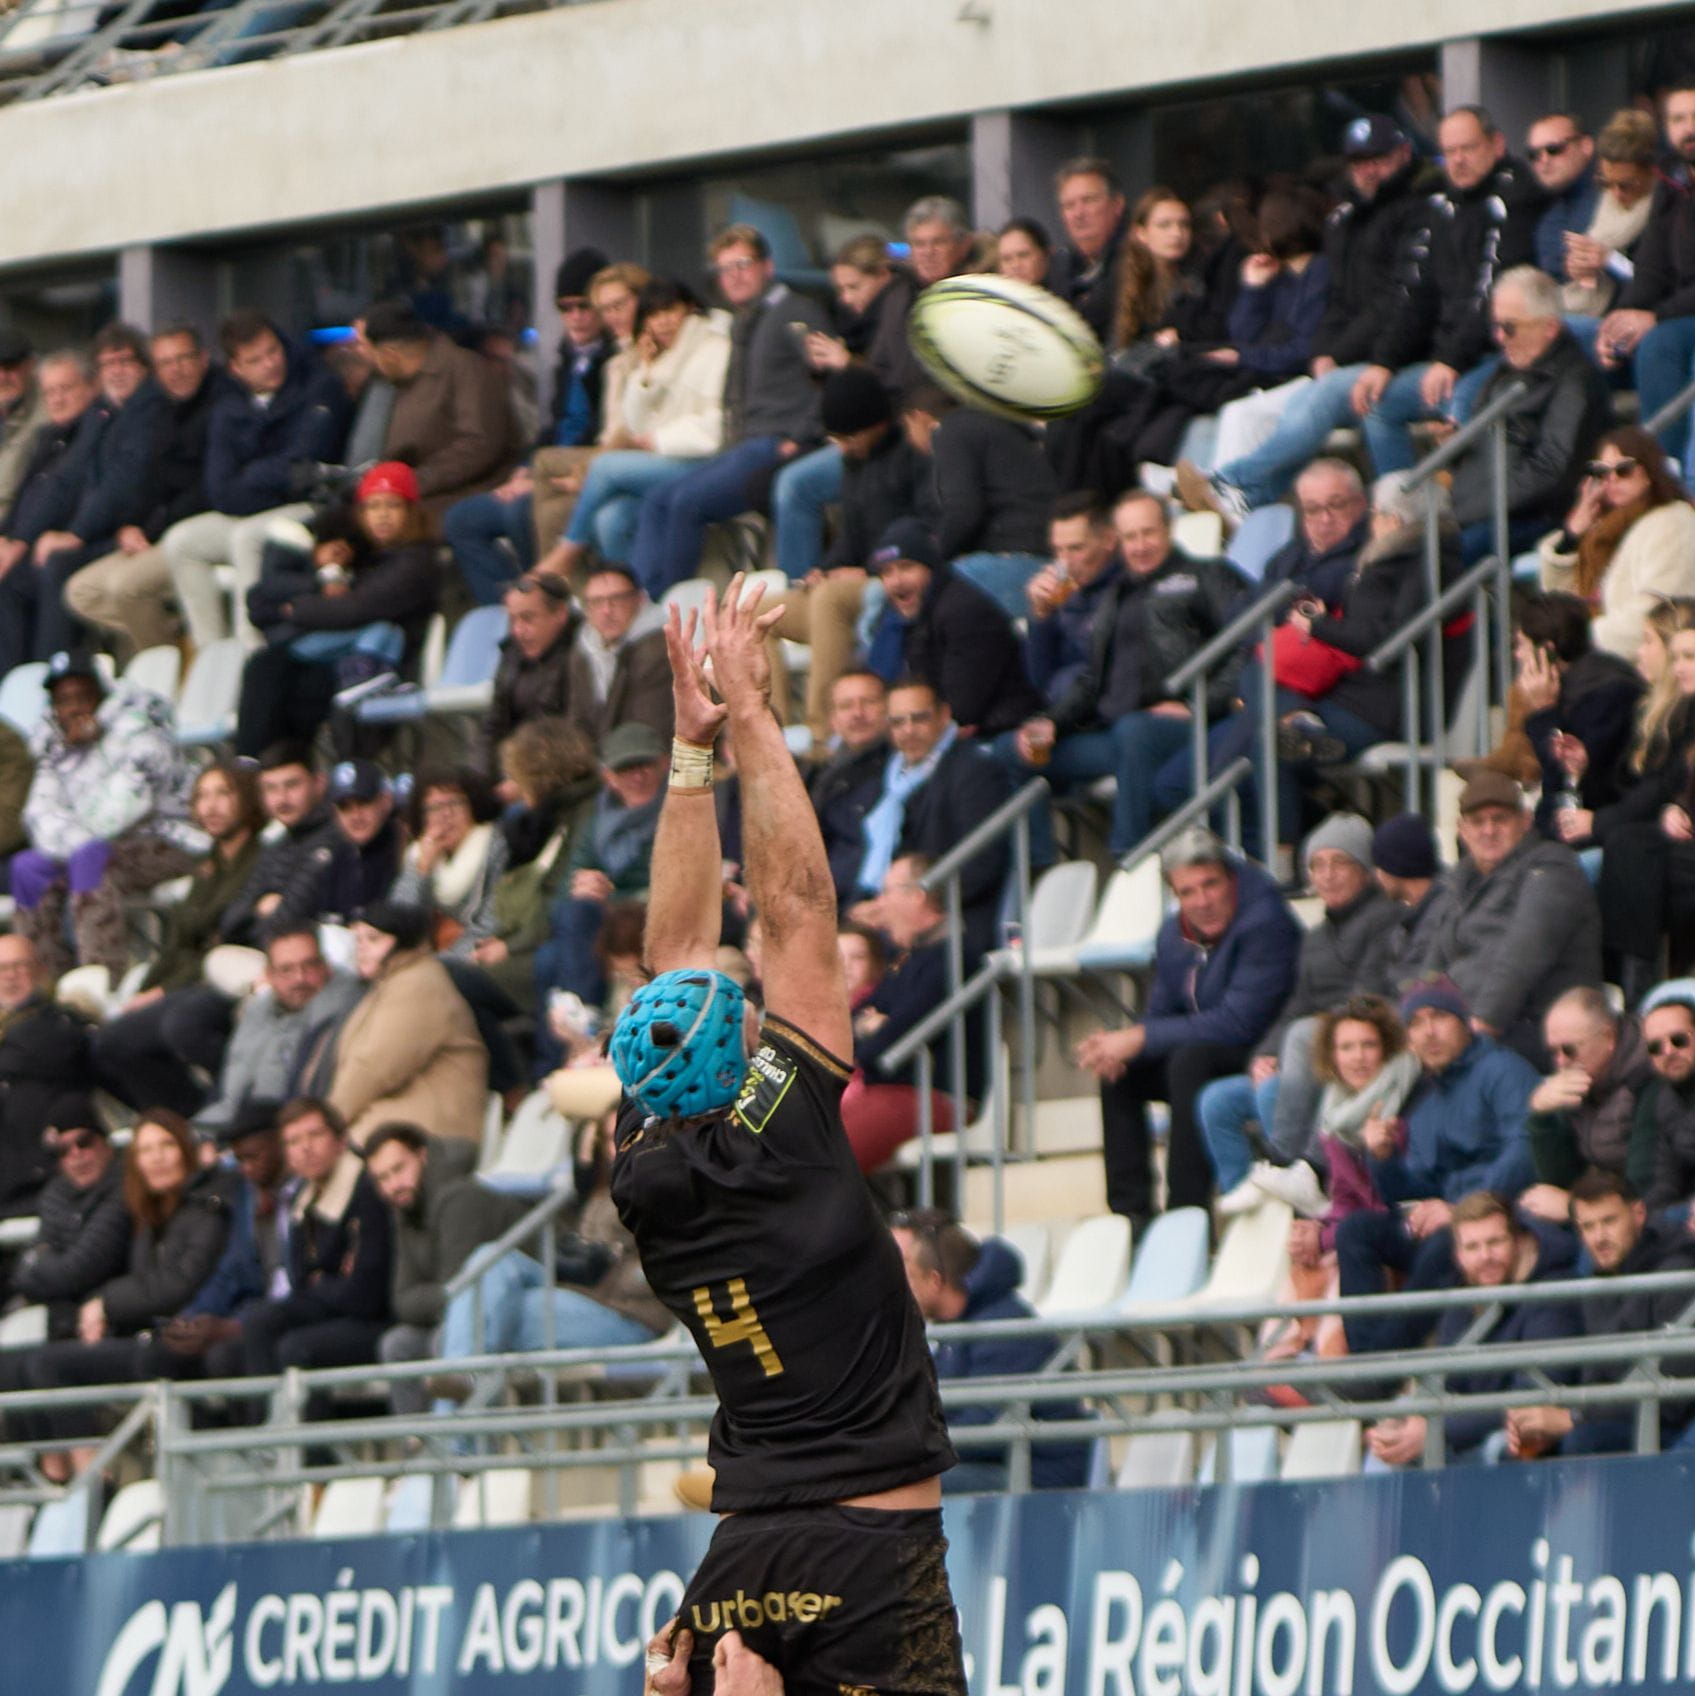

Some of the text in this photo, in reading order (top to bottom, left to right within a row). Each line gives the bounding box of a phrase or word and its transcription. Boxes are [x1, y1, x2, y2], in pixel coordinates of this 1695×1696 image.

[693, 1277, 785, 1378] 4
[240, 1566, 700, 1688] CRÉDIT AGRICO
